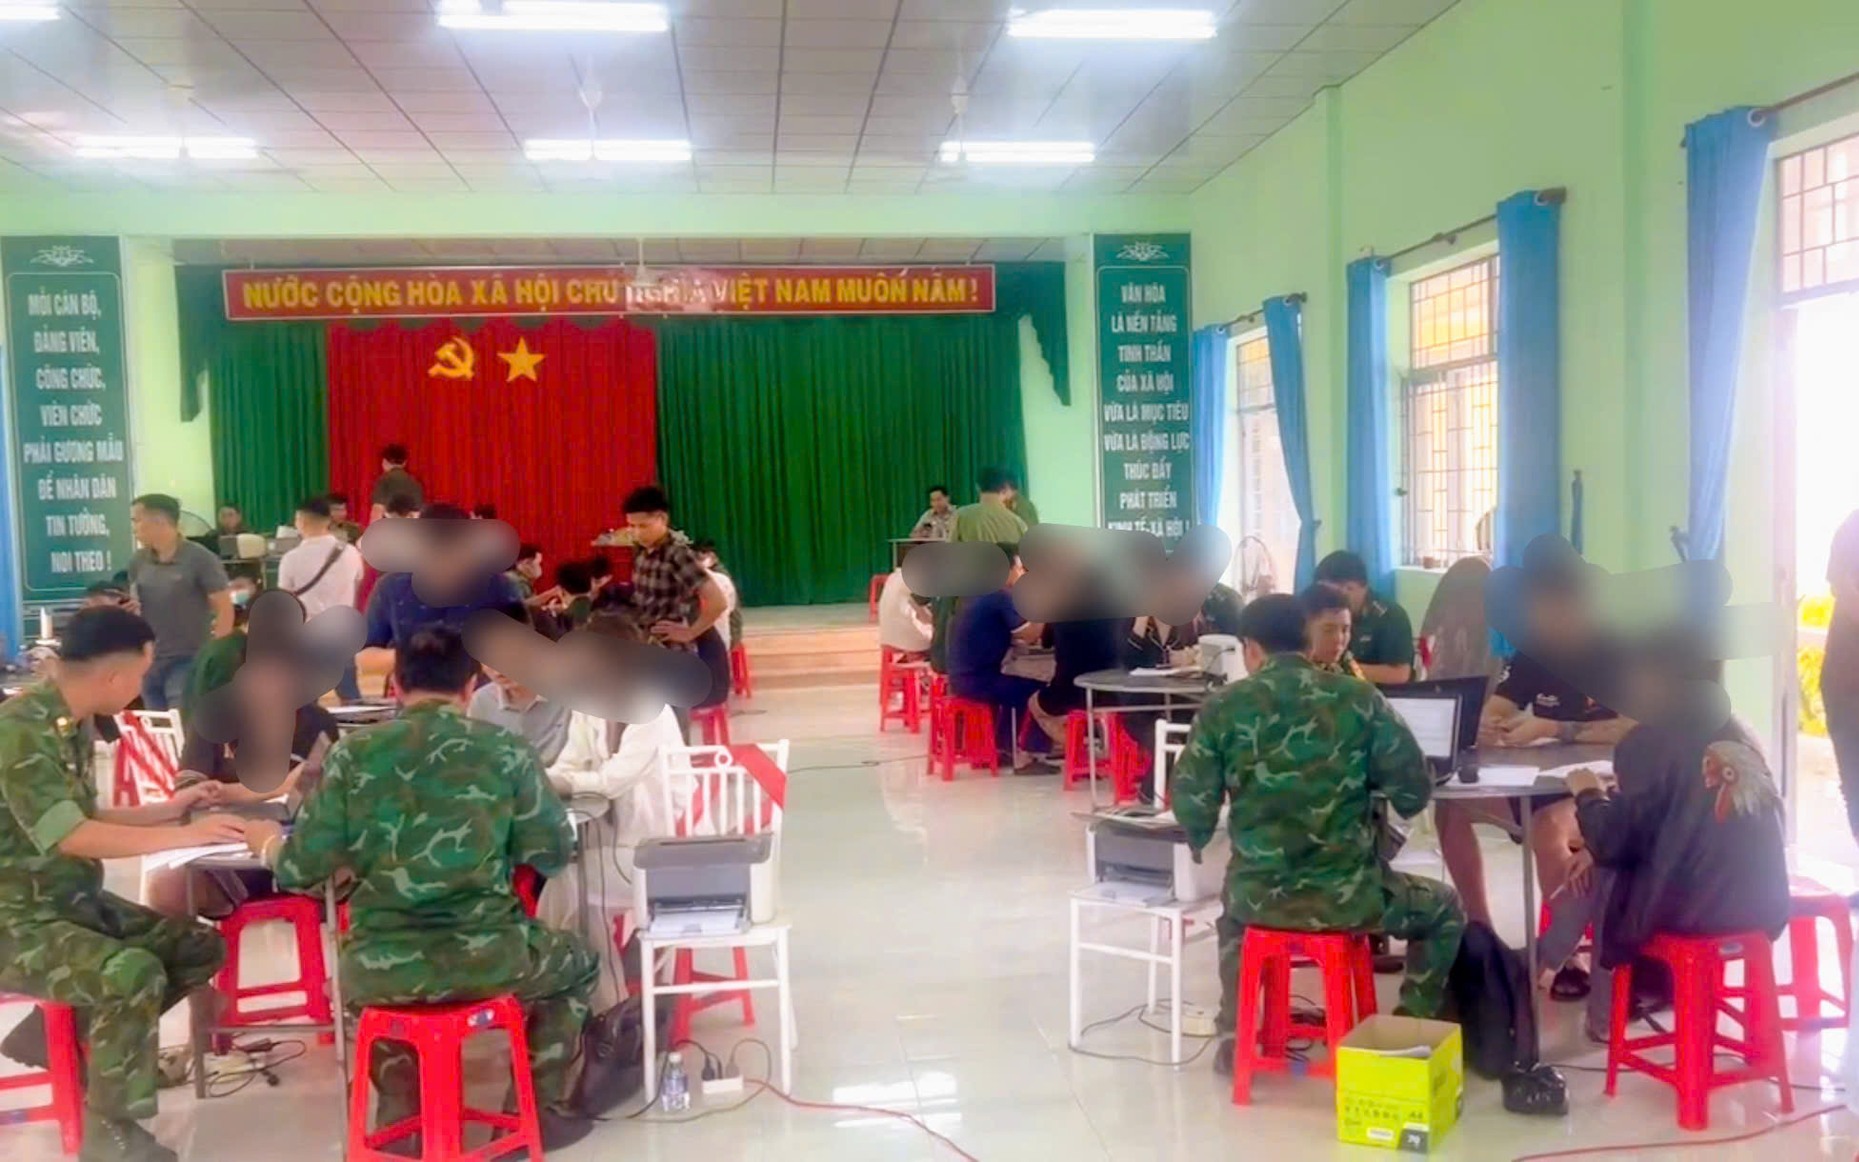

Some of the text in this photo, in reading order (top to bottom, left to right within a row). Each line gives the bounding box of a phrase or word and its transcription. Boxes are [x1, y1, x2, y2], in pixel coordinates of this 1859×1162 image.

[325, 274, 402, 314] CỘNG
[406, 272, 463, 306] HÒA
[470, 272, 508, 305] XÃ
[515, 272, 560, 312] HỘI
[712, 271, 769, 311] VIỆT
[774, 277, 832, 303] NAM
[912, 271, 967, 303] NĂM
[971, 277, 979, 302] !
[46, 514, 66, 536] TIN
[74, 551, 104, 572] THEO
